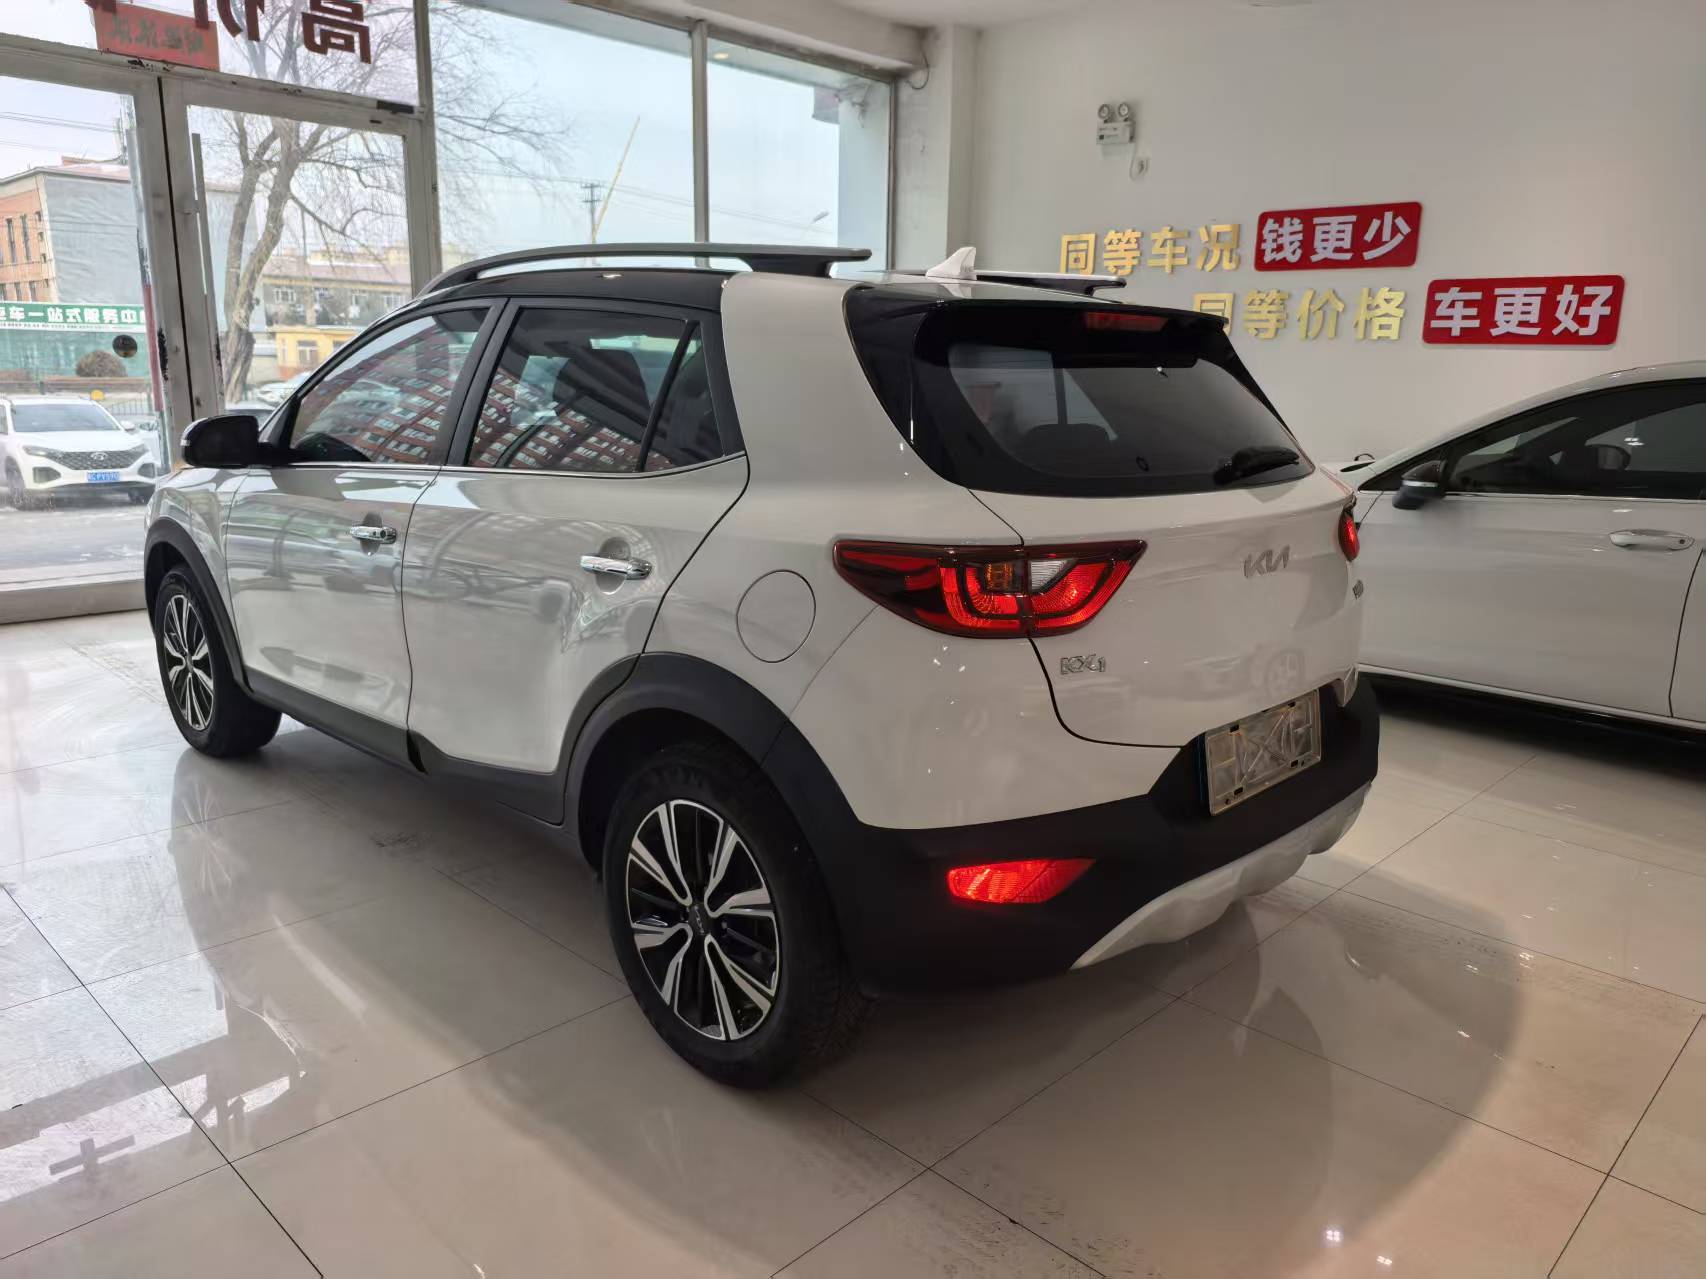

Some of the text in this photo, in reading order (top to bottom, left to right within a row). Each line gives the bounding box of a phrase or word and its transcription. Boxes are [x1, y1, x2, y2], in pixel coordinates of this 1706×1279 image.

[1059, 210, 1412, 276] 同等车况 钱更少
[1429, 283, 1615, 337] 车更好
